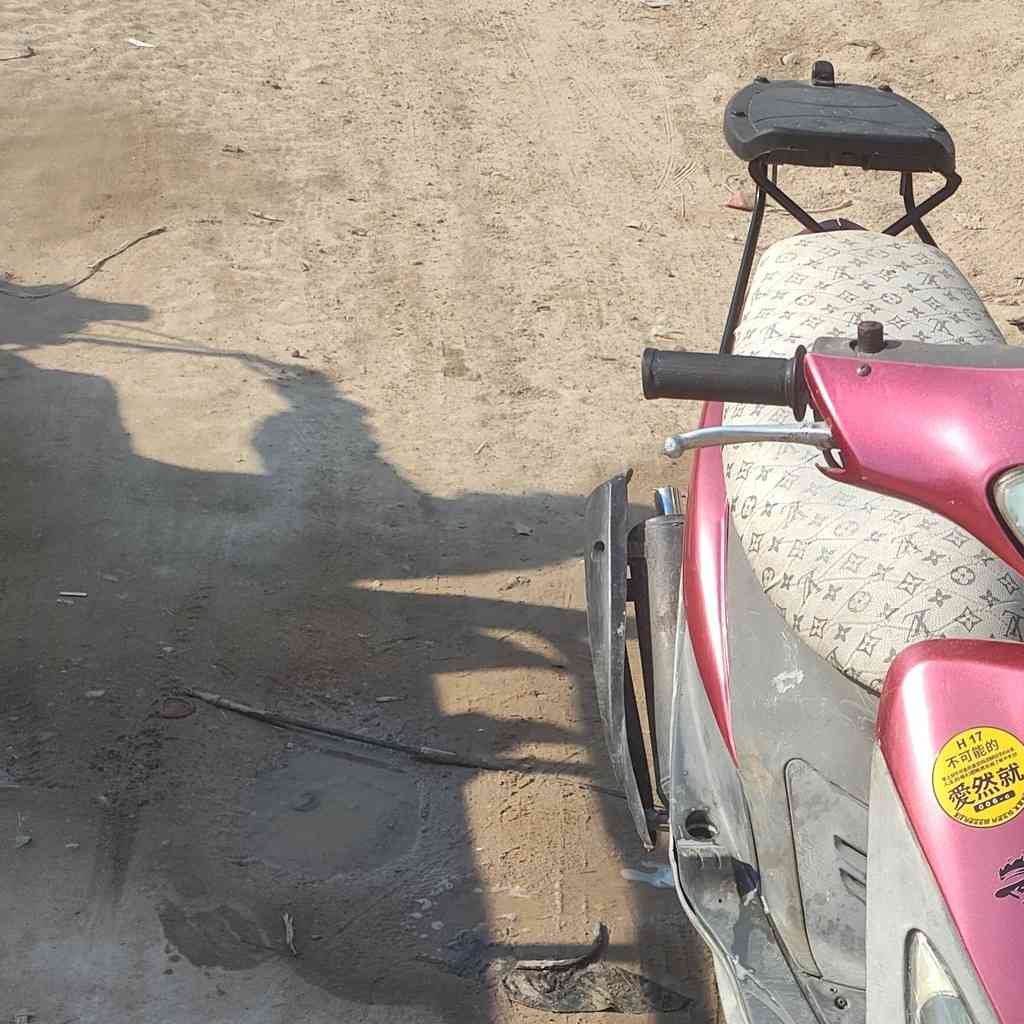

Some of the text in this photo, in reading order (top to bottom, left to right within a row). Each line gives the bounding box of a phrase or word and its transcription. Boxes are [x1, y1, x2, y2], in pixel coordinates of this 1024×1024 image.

[945, 739, 999, 769] 不可能的
[955, 731, 983, 750] H 17
[948, 762, 1024, 812] 愛然就
